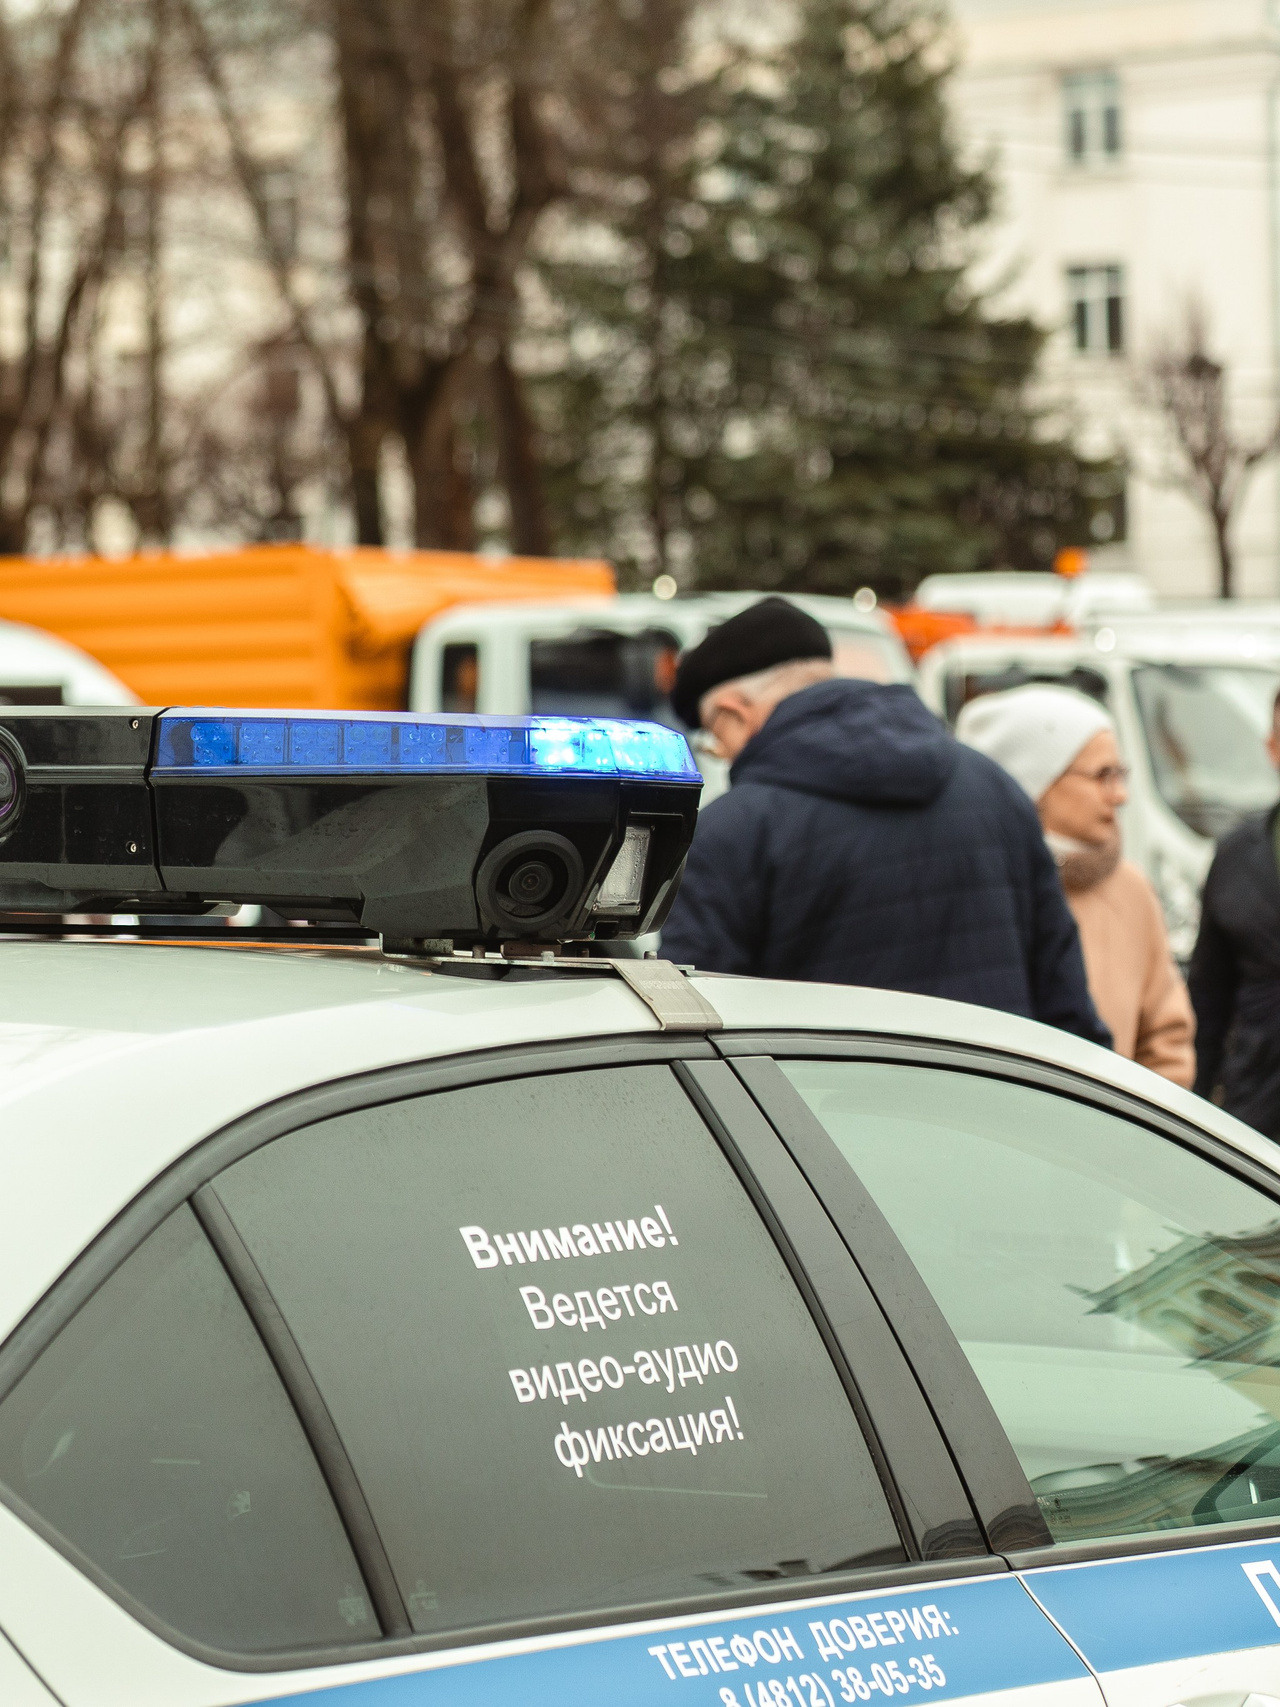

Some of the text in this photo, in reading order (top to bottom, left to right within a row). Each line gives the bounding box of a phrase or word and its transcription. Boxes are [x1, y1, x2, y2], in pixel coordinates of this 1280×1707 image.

[459, 1204, 679, 1269] Внимание!
[519, 1280, 679, 1332] Ведется
[508, 1339, 739, 1405] видео-аудио
[553, 1396, 744, 1478] фиксация!
[647, 1604, 960, 1681] ТЕЛЕФОН ДОВЕРИЯ:
[830, 1654, 947, 1703] 38-05-35
